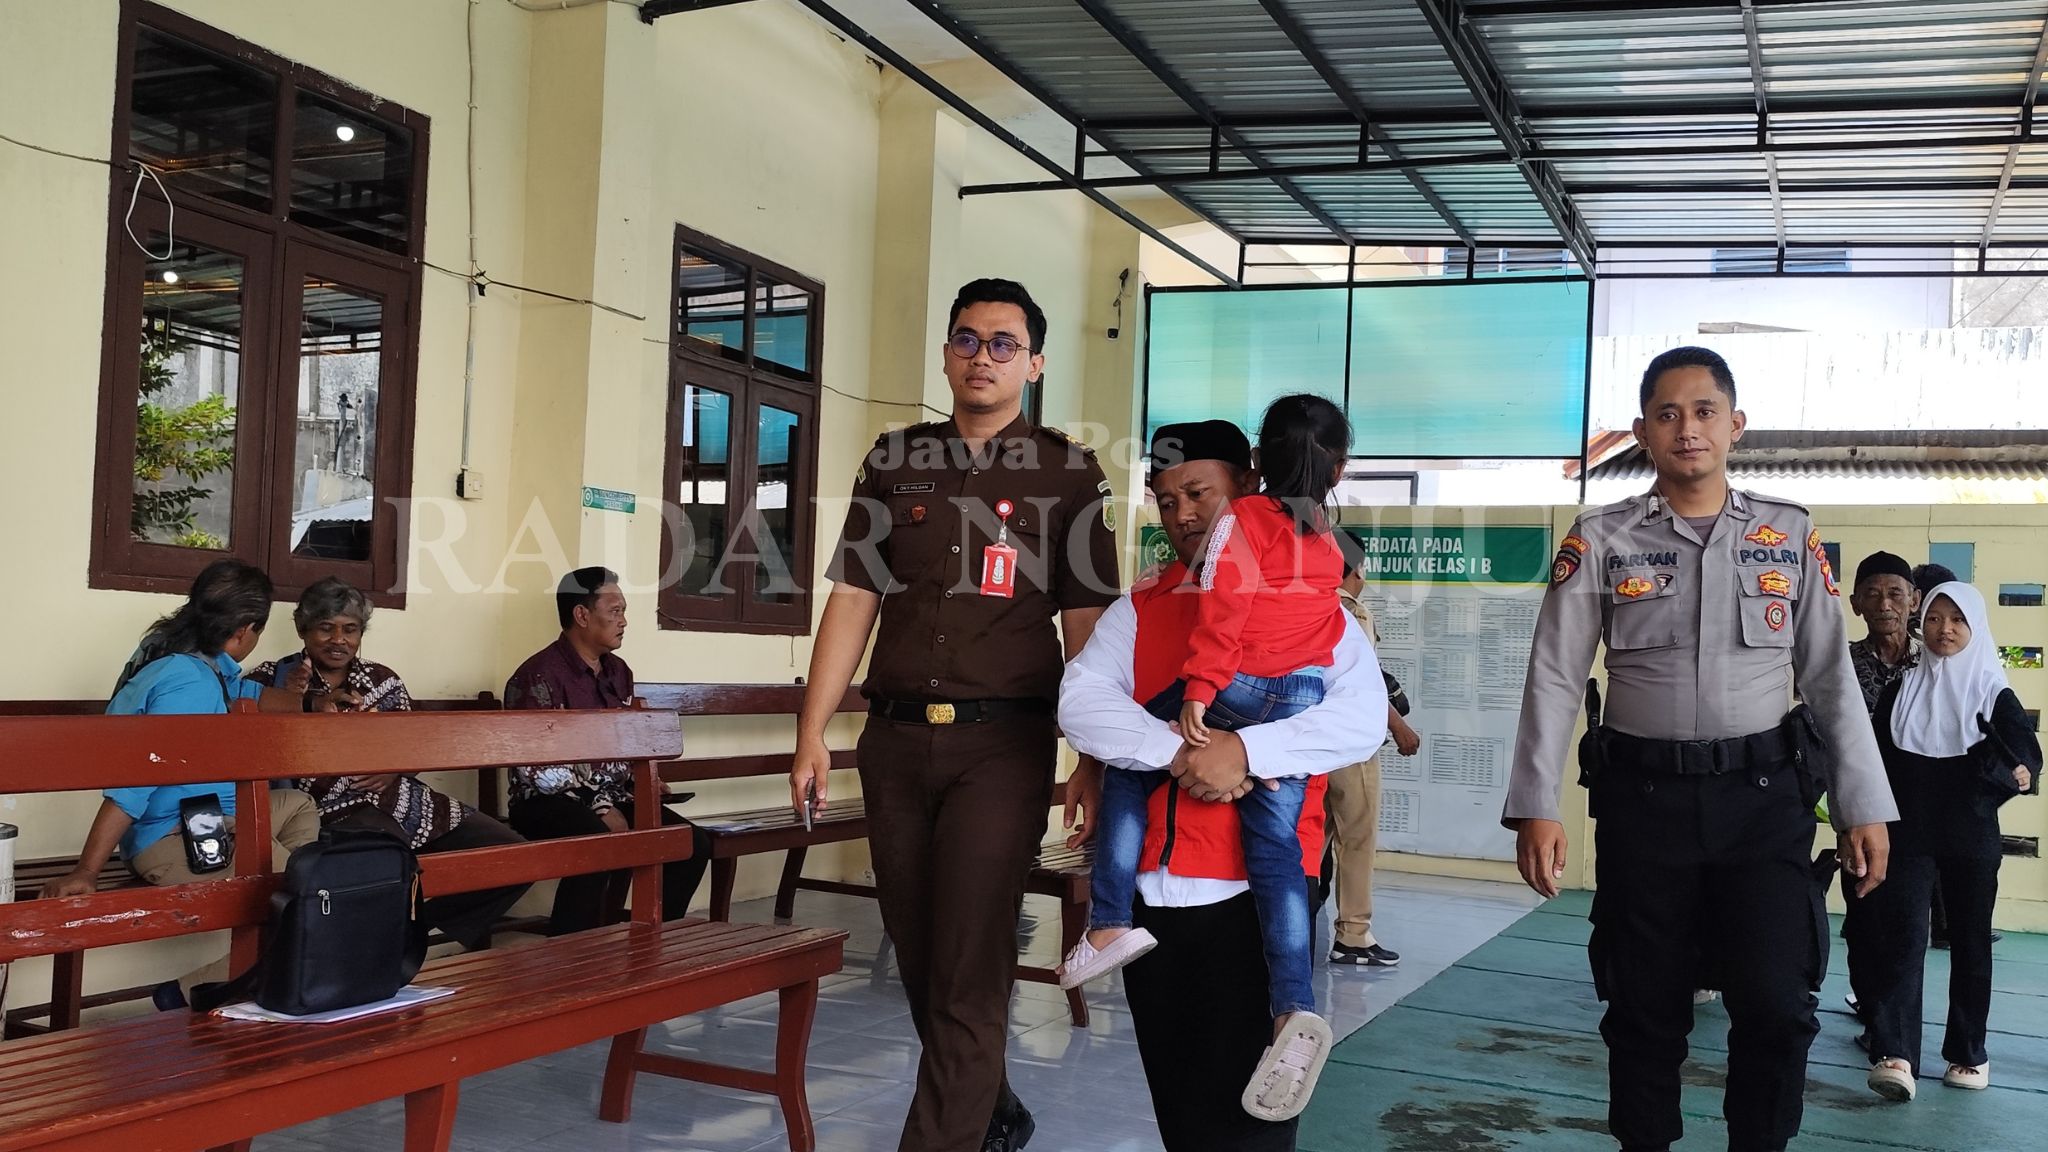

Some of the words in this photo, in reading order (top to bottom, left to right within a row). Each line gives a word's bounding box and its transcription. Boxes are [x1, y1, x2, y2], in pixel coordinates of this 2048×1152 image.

[1361, 536, 1418, 554] ERDATA
[1423, 537, 1463, 554] PADA
[1364, 556, 1413, 573] ANJUK
[1417, 557, 1466, 574] KELAS
[1482, 558, 1492, 575] B
[1609, 551, 1678, 570] FARHAN
[1740, 548, 1799, 565] POLRI
